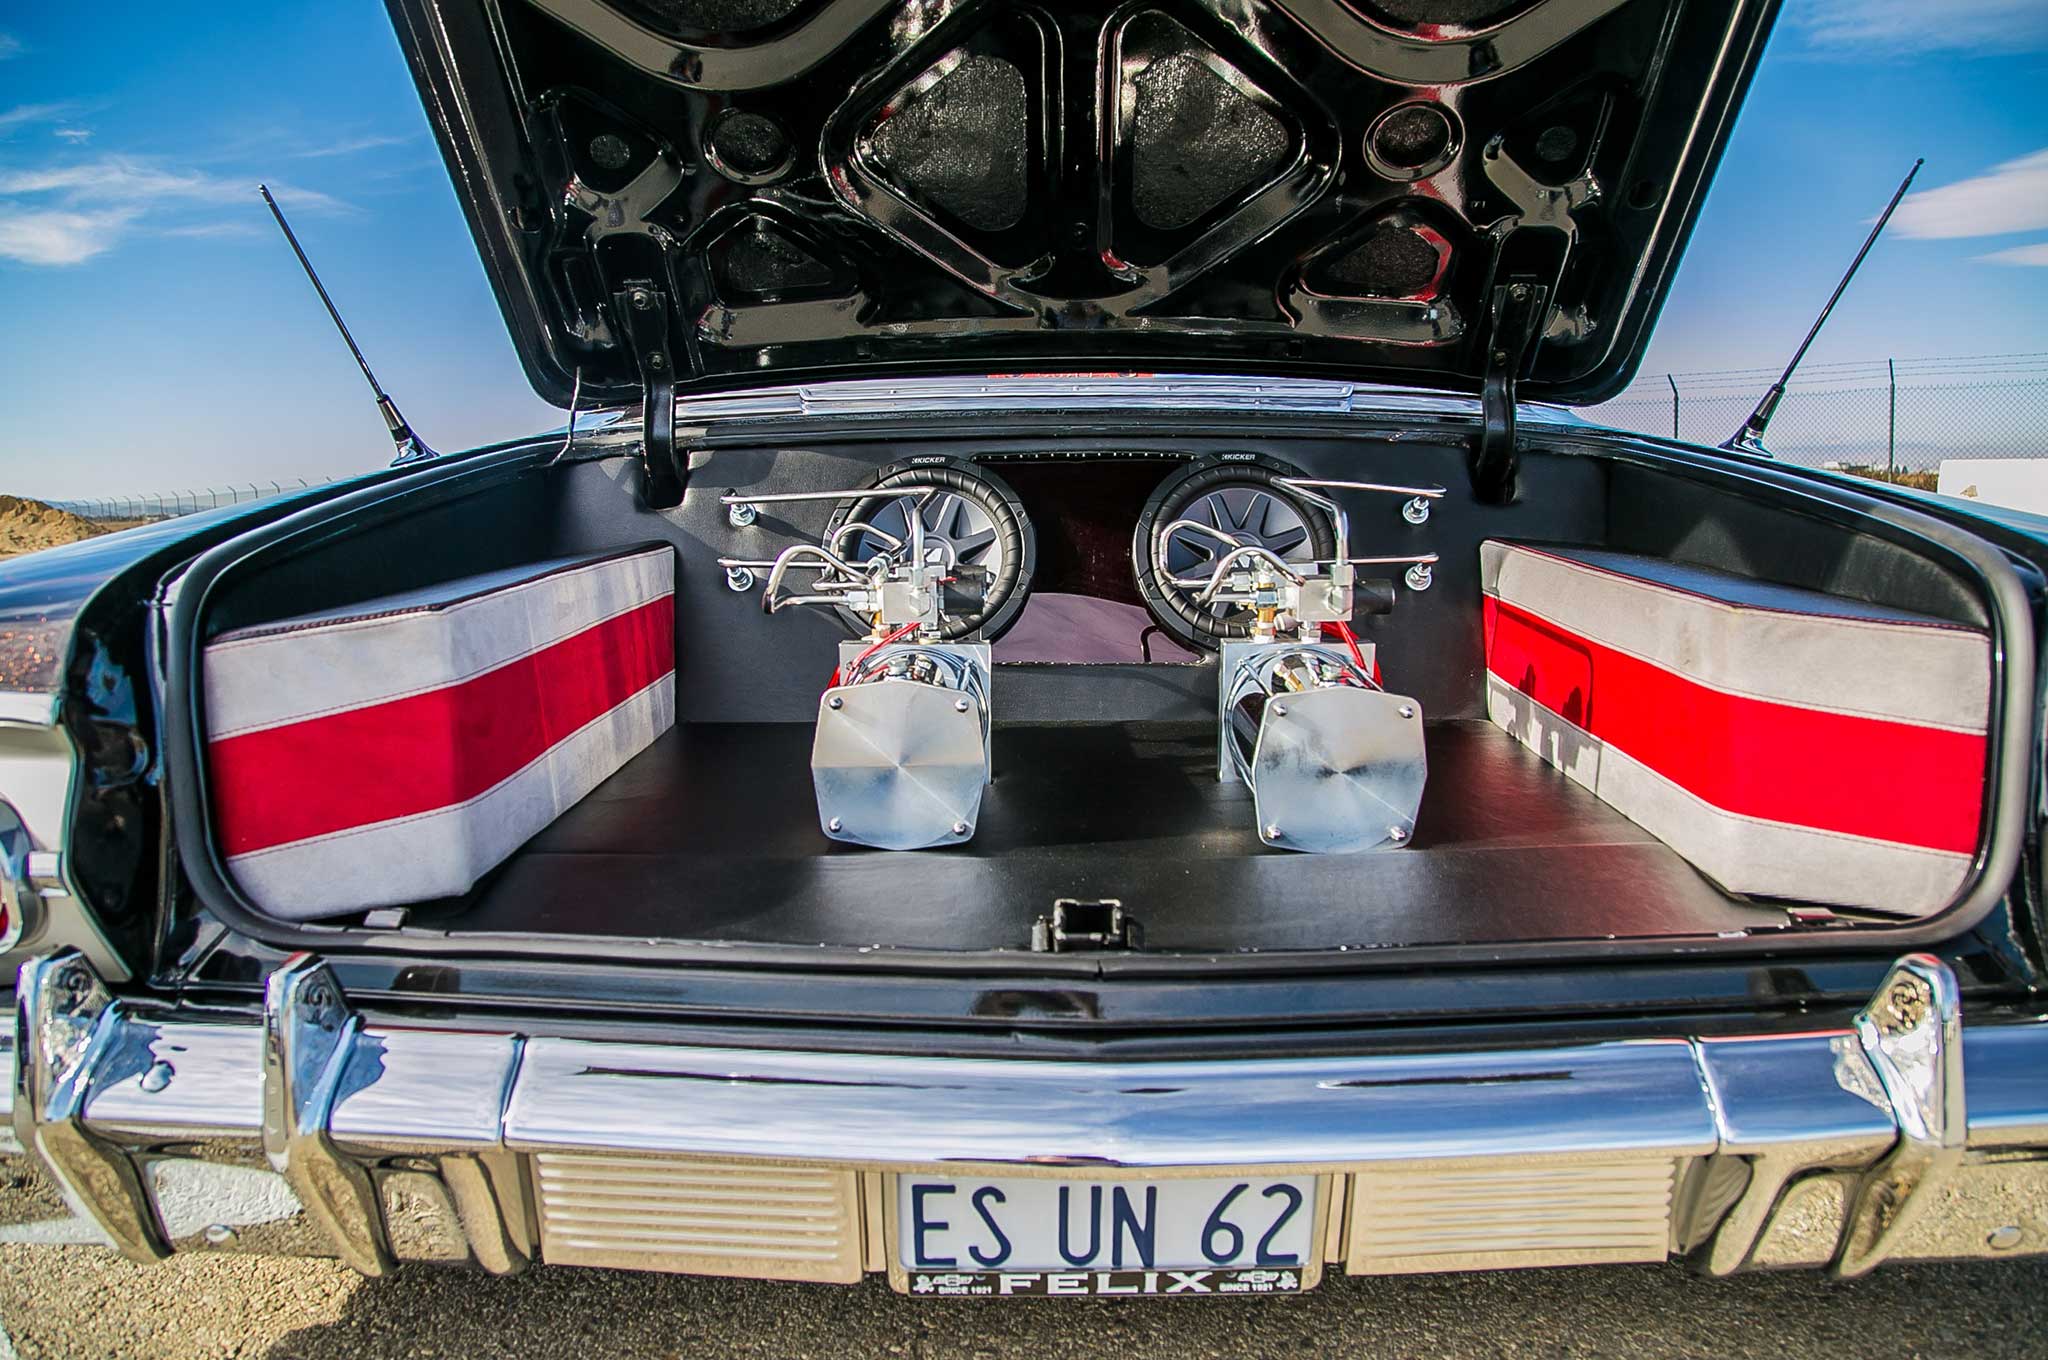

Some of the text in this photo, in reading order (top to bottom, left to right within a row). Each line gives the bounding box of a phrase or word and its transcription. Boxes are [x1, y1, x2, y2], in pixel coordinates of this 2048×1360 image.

[911, 456, 946, 464] KICKER
[1222, 453, 1256, 461] KICKER
[912, 1183, 1303, 1268] ES UN 62
[999, 1271, 1213, 1295] FELIX
[1219, 1282, 1250, 1292] SINCE
[938, 1286, 968, 1294] SINCE
